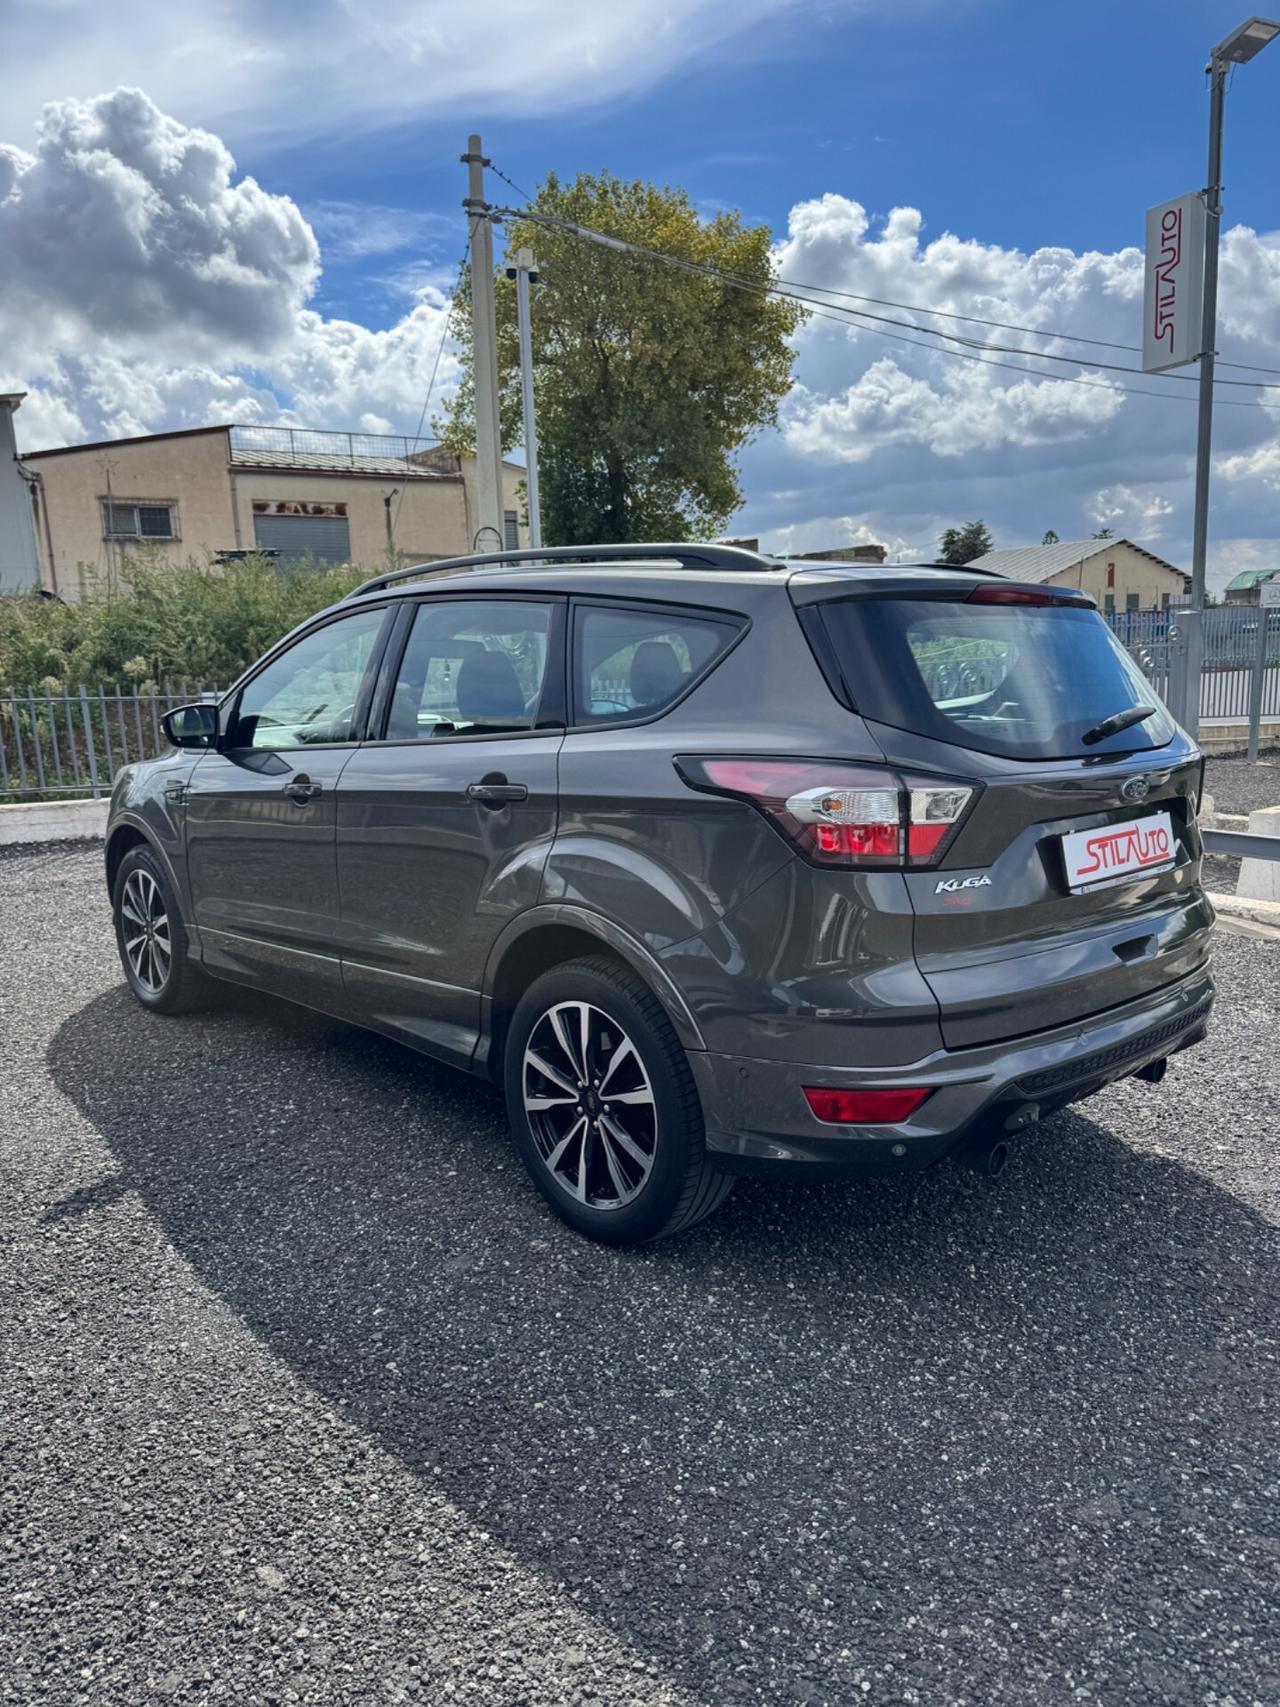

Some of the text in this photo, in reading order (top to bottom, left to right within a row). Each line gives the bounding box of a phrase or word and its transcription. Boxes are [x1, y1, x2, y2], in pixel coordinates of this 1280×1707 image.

[1154, 207, 1182, 354] STILAUTO
[1076, 823, 1169, 876] STILAUTO
[934, 874, 993, 895] KUGA
